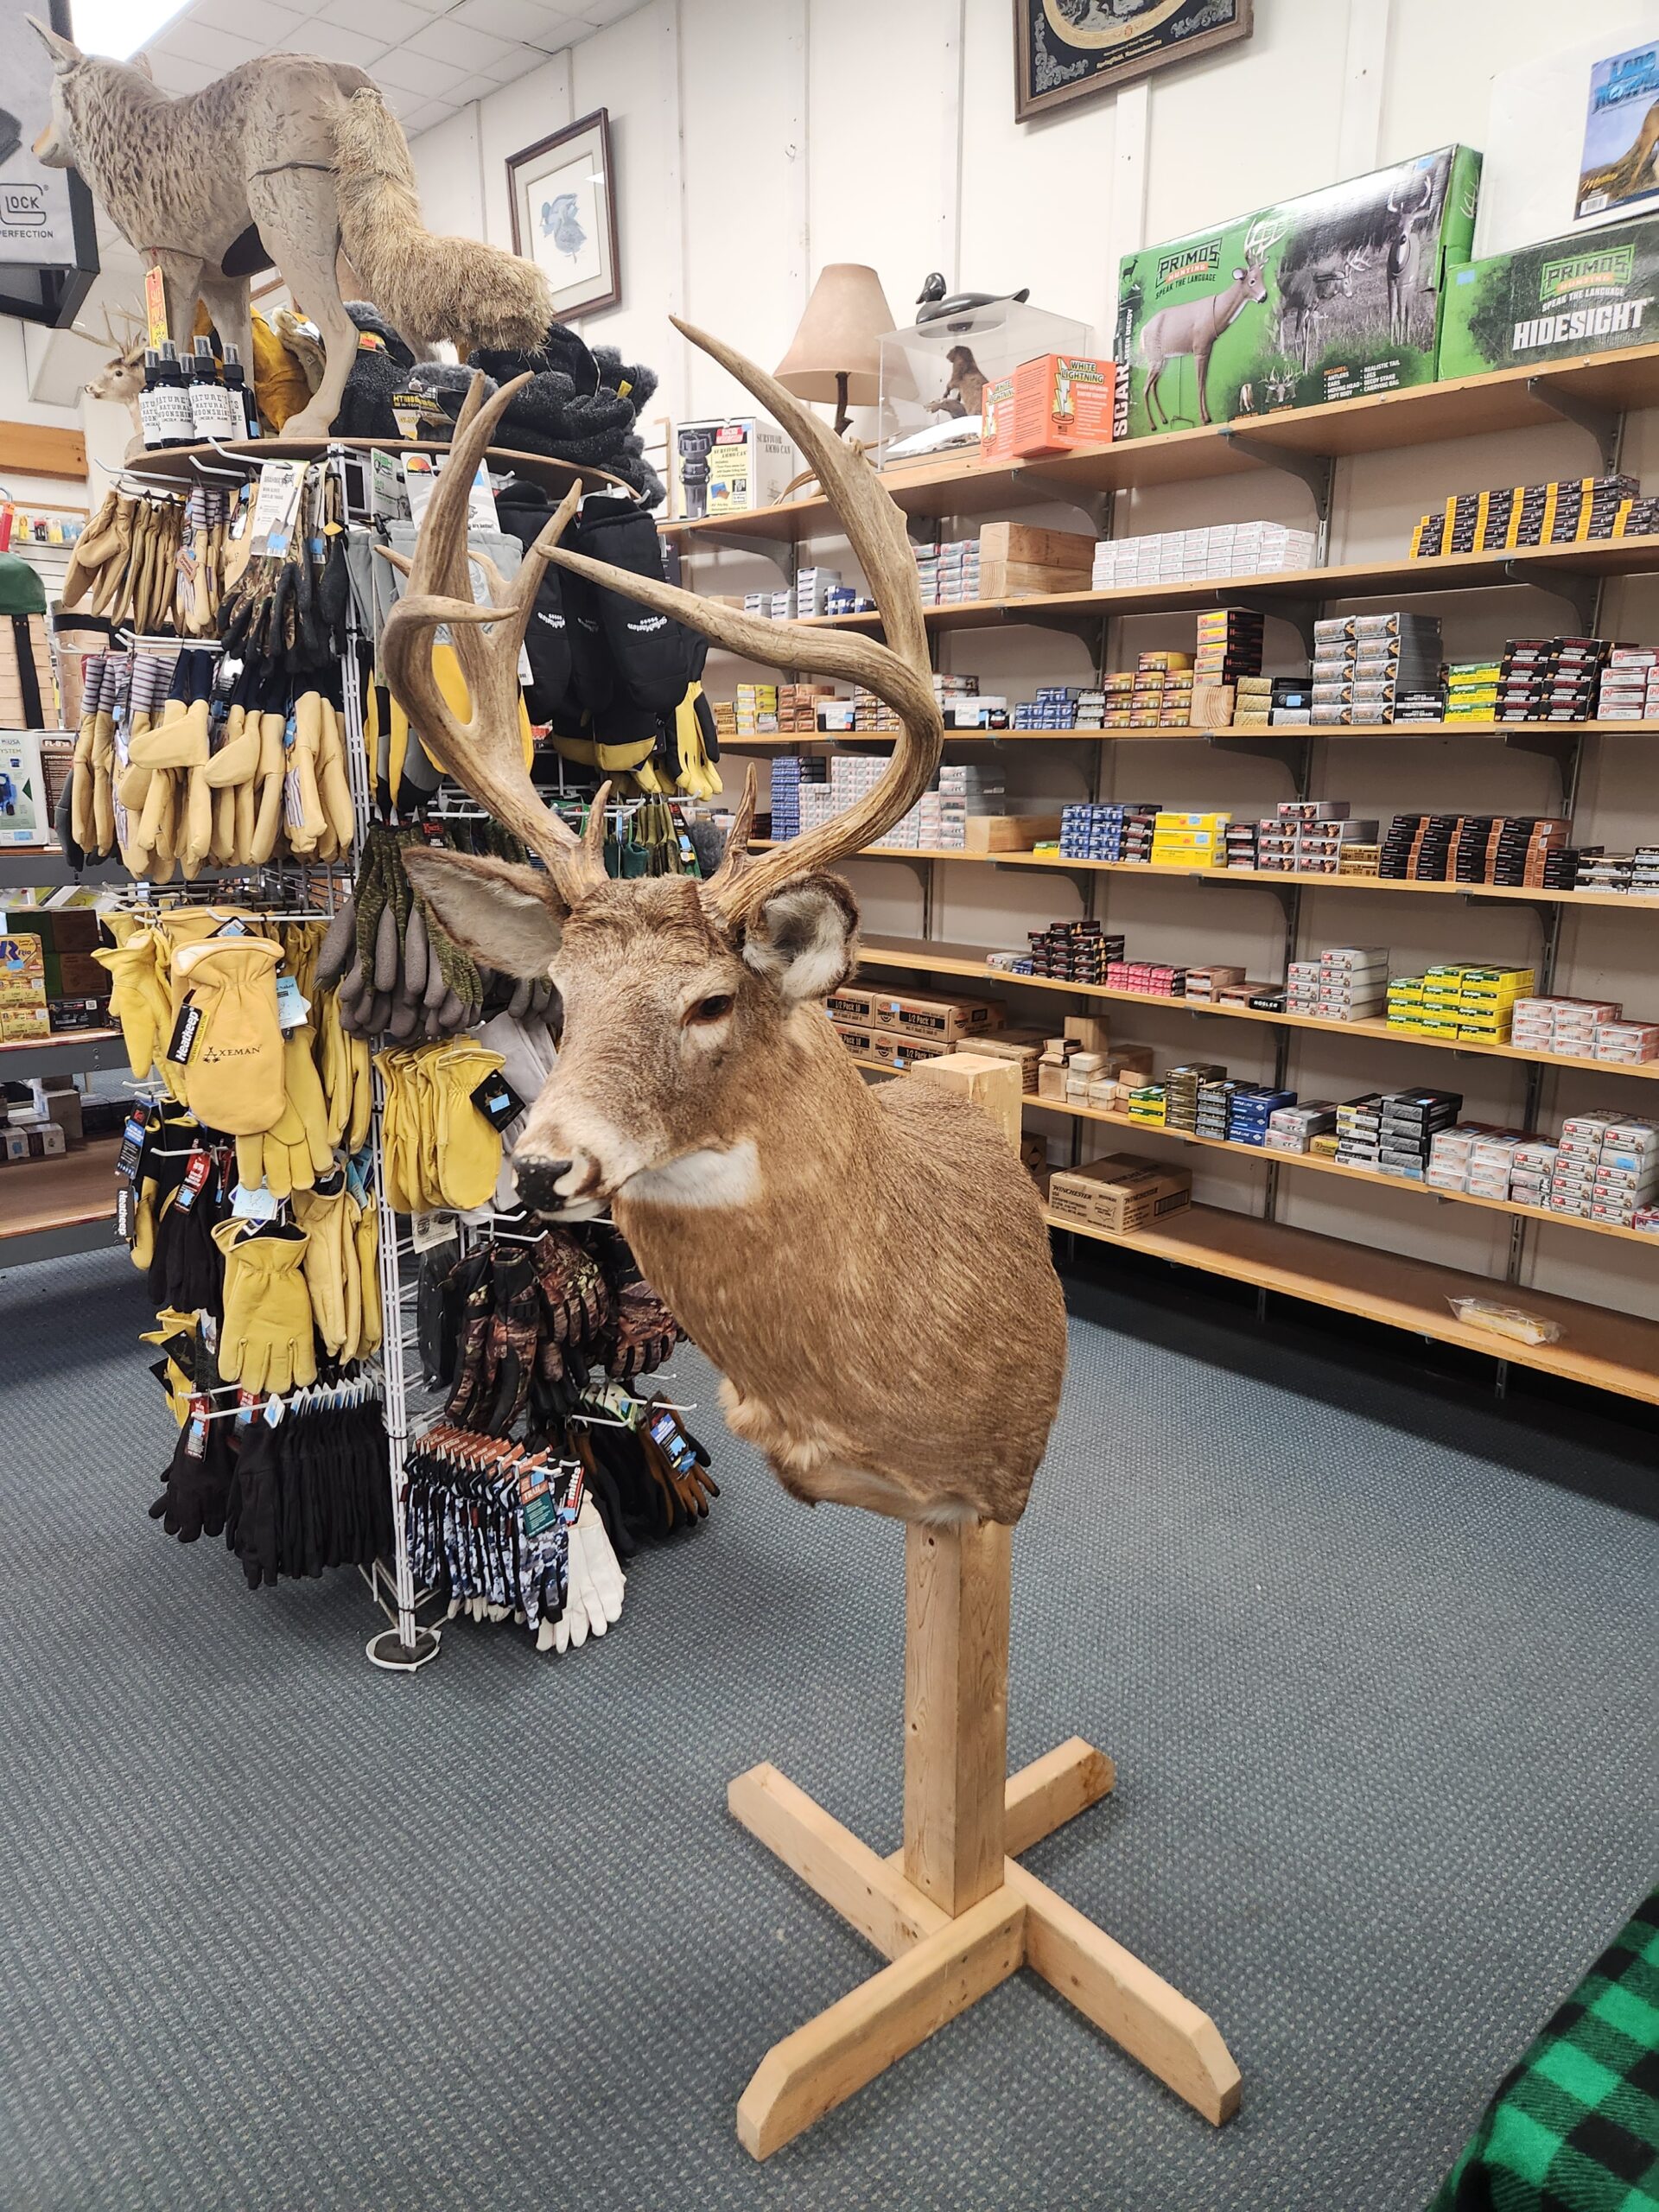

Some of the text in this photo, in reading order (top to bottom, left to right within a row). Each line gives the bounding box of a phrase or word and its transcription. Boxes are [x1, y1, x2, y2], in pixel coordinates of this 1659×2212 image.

[0, 230, 53, 238] ERFECTION
[1160, 242, 1220, 279] PRIMOS
[1167, 264, 1207, 281] HUNTING
[1546, 254, 1628, 289] PRIMOS
[1155, 273, 1217, 300] SPEAK THE LANGUAGE
[1542, 287, 1624, 312] SPEAK THE LANGUAGE
[1512, 301, 1649, 351] HIDESIGHT
[1071, 360, 1096, 372] WHITE
[1363, 362, 1389, 372] REALISTIC
[1062, 368, 1104, 383] LIGHTNING
[1328, 372, 1350, 381] ANTLERS
[1363, 373, 1396, 386] DECOY STAKE
[1328, 381, 1360, 395] MOVING HEAD
[1363, 383, 1389, 392] CARRYING
[1327, 392, 1341, 401] SOFT
[780, 446, 791, 454] CAN
[843, 1002, 854, 1012] Pack
[1253, 1000, 1278, 1008] NOSLER
[917, 1015, 929, 1026] Pack
[175, 1010, 200, 1062] Heatkeep
[843, 1033, 855, 1043] Pack
[1052, 1185, 1092, 1200] WINCHESTER
[118, 1190, 127, 1236] Heatkeep
